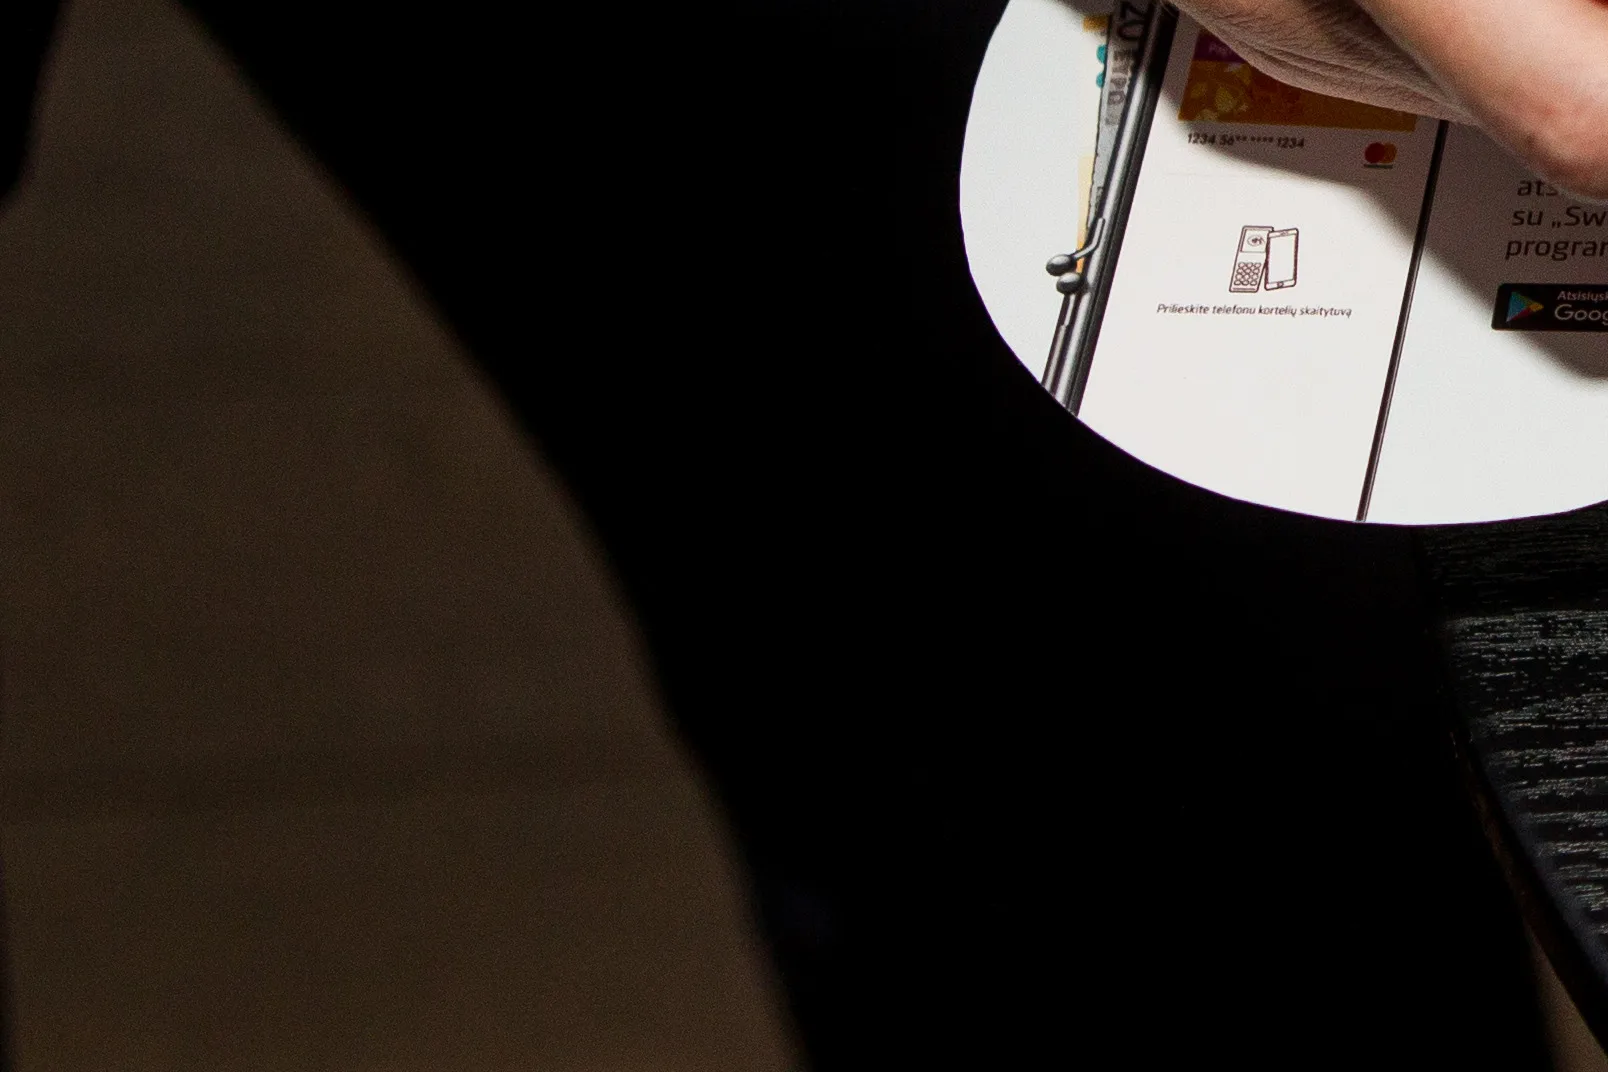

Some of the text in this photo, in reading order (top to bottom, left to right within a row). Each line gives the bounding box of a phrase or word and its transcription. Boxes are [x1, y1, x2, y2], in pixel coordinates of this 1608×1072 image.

[1187, 133, 1216, 145] 1234
[1276, 136, 1305, 149] 1234
[1517, 179, 1560, 197] ats
[1512, 209, 1543, 227] su
[1156, 303, 1210, 315] Prilieskite
[1212, 304, 1256, 315] telefonu
